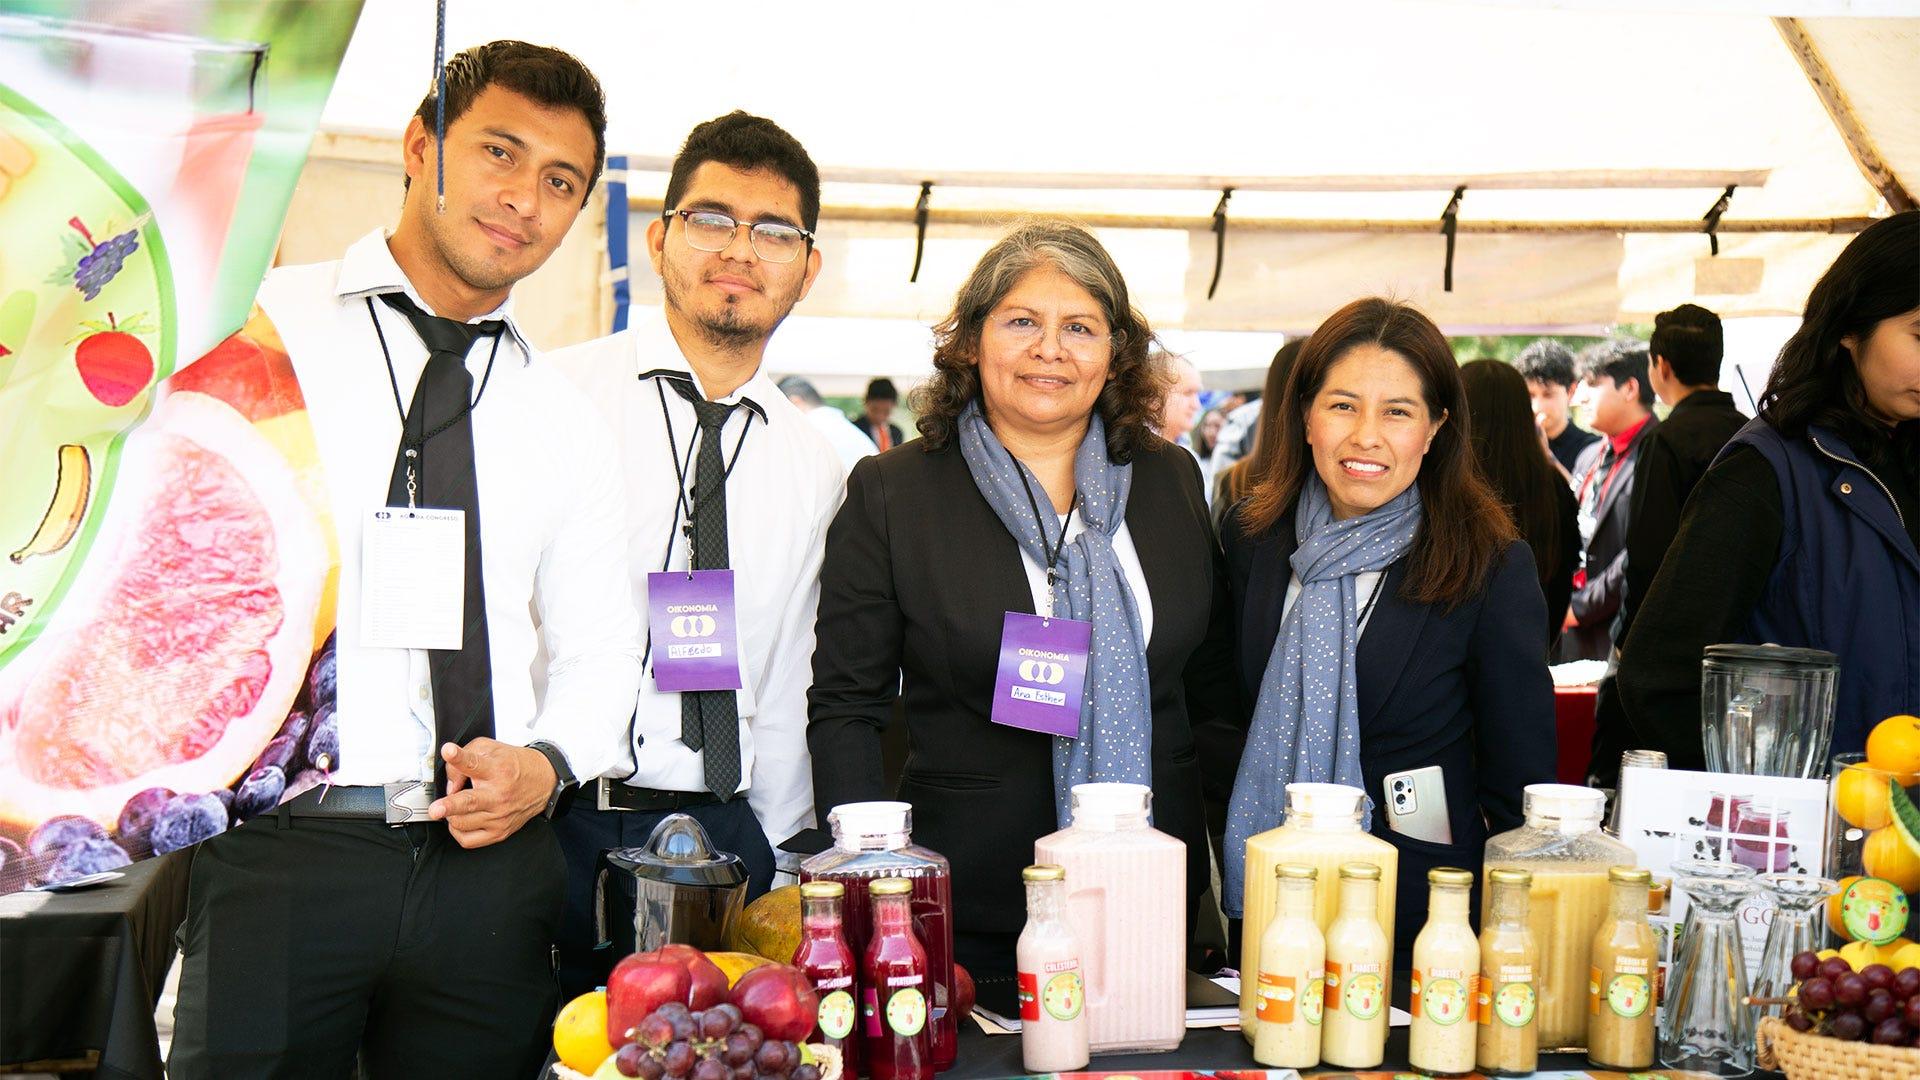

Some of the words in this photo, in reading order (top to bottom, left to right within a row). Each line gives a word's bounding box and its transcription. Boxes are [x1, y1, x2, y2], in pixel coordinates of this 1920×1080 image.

[667, 604, 718, 614] OIKONOMIA
[1018, 647, 1070, 662] OIKONOMIA
[1013, 687, 1031, 699] Ana
